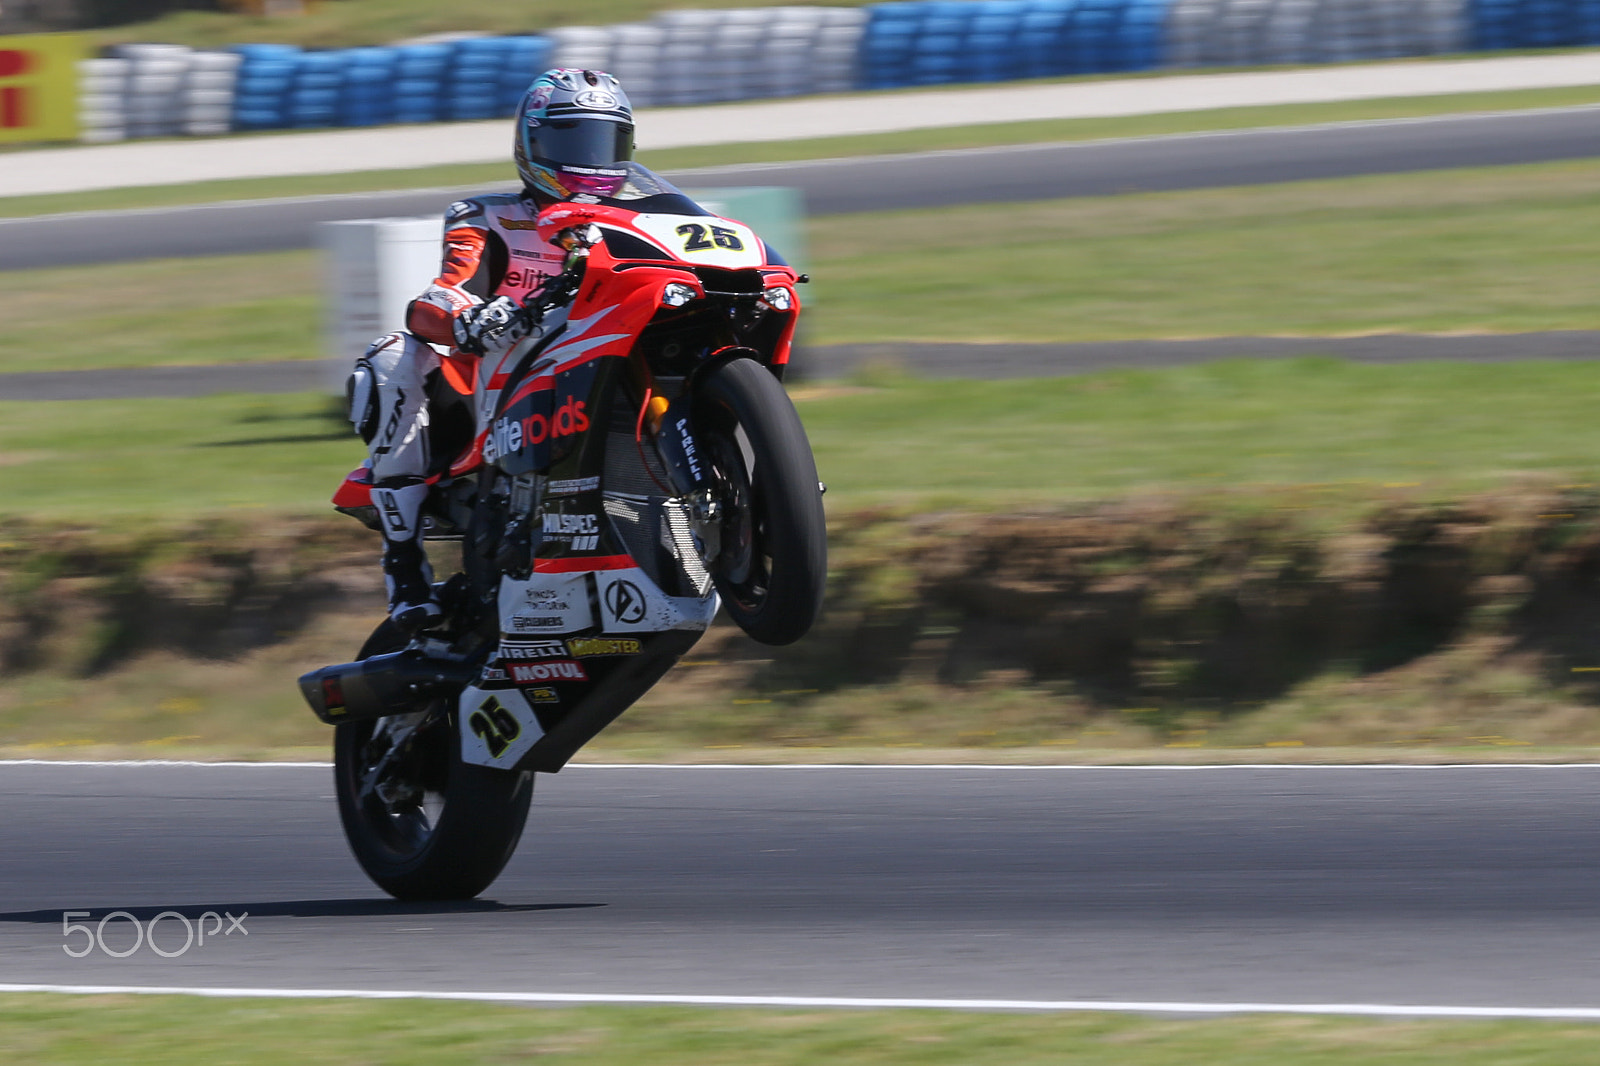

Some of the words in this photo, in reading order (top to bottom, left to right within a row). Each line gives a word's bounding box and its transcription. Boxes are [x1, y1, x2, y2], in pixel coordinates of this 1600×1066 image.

[675, 223, 745, 254] 25
[506, 268, 548, 290] elit
[675, 418, 702, 482] PIRELLI
[542, 513, 599, 534] MILSPEC
[513, 663, 585, 682] MOTUL
[468, 694, 522, 759] 25
